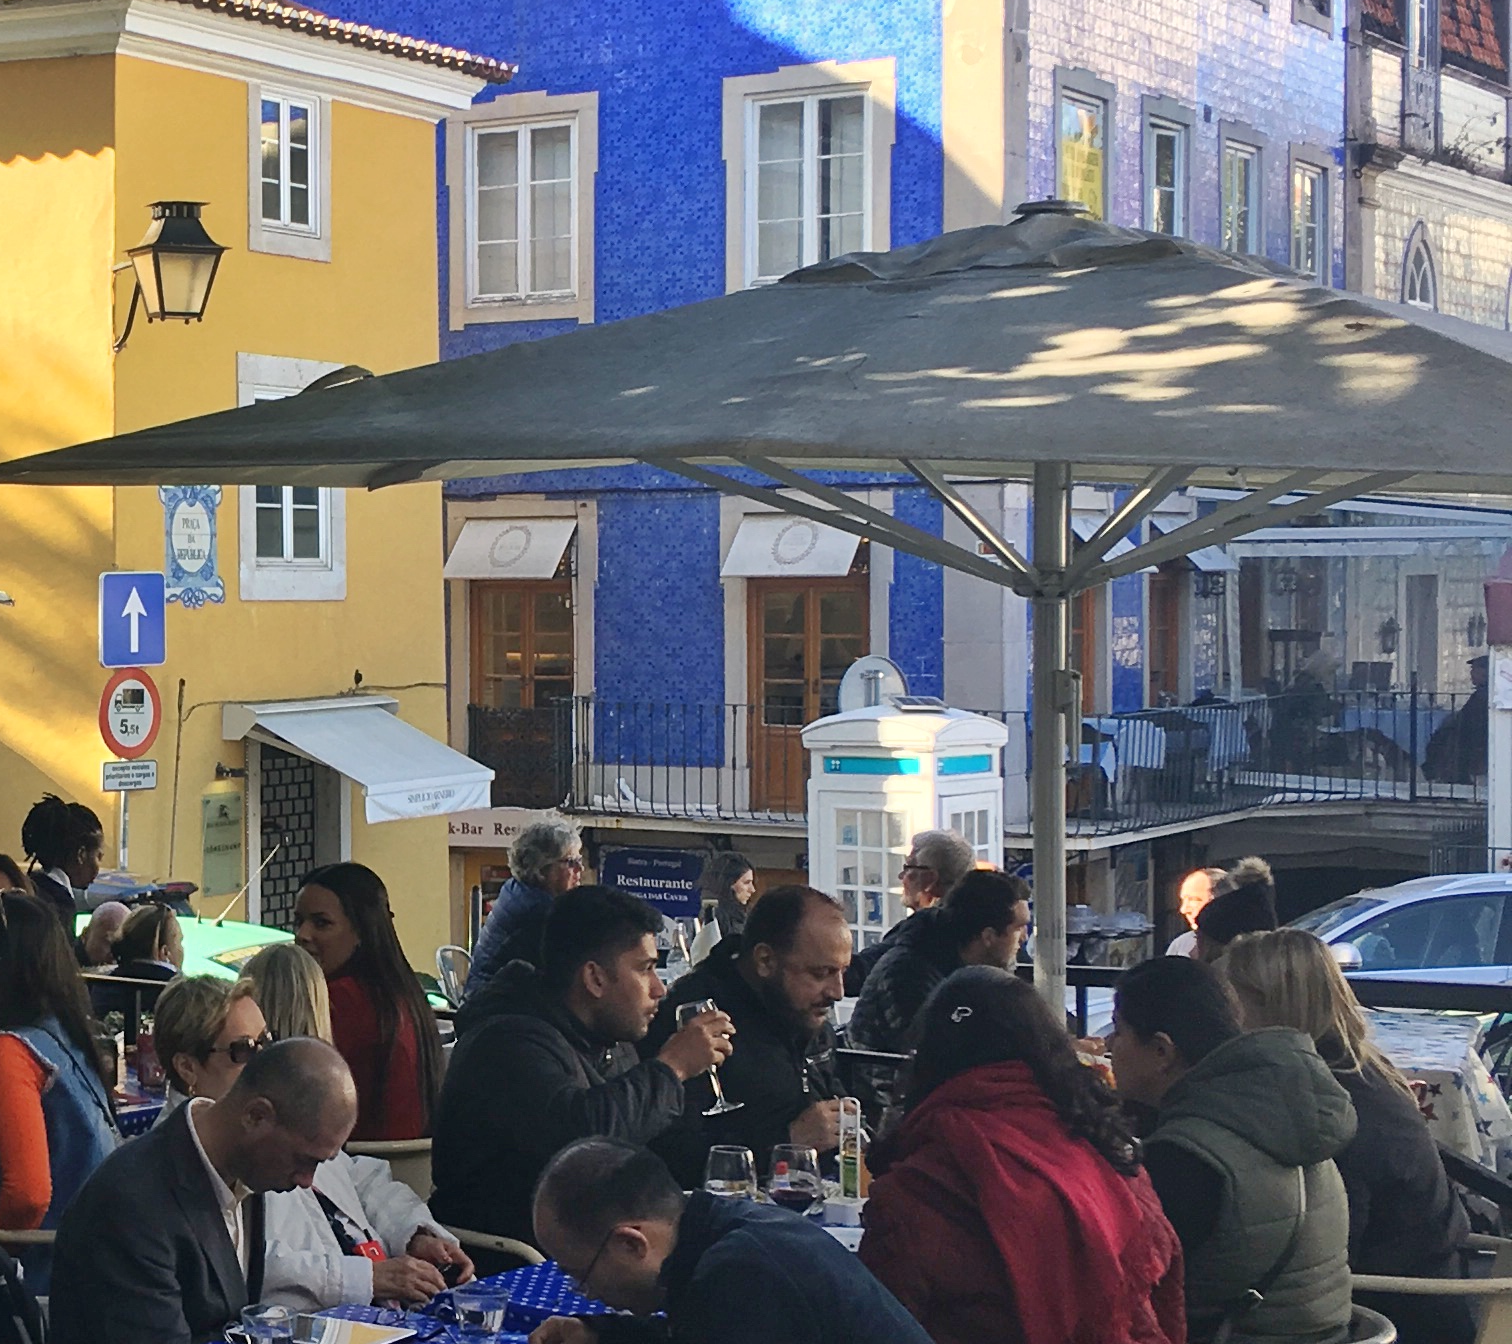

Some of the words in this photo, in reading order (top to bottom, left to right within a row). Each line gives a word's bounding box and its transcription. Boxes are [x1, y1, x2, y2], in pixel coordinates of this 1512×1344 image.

[119, 718, 140, 736] 5,5t
[448, 822, 484, 835] k-Bar
[616, 874, 694, 890] Restaurante
